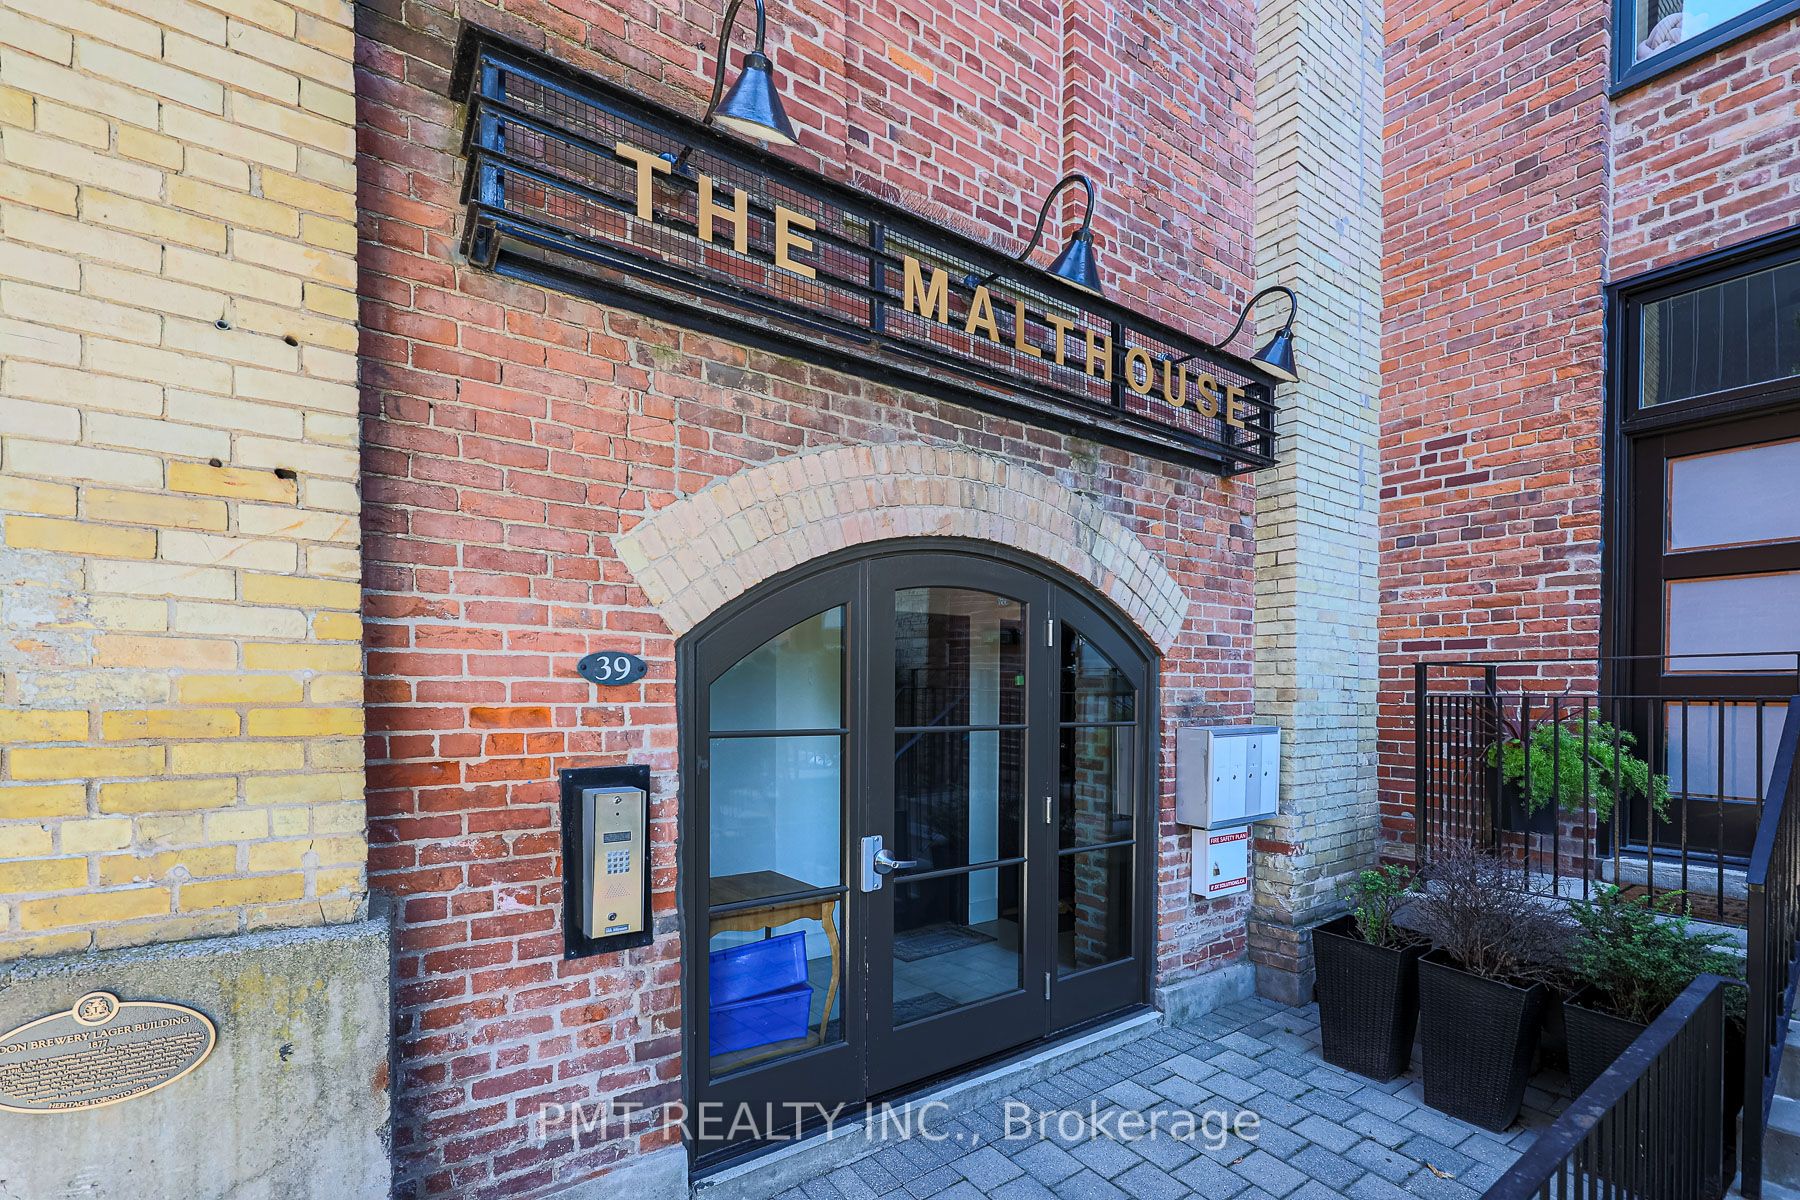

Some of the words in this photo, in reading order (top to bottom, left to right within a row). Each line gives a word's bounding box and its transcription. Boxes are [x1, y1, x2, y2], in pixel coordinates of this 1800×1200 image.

[616, 142, 816, 280] THE
[904, 255, 1245, 428] MALTHOUSE
[595, 656, 632, 681] 39
[1220, 835, 1234, 843] SAFETY
[1235, 833, 1246, 841] PLAN
[31, 1032, 90, 1050] BREWERY
[93, 1026, 132, 1038] LAGER
[136, 1015, 191, 1033] BUILDING
[88, 1039, 109, 1049] 1877
[49, 1101, 90, 1109] HERITAGE
[91, 1091, 131, 1104] TORONTO
[132, 1085, 148, 1094] 2022
